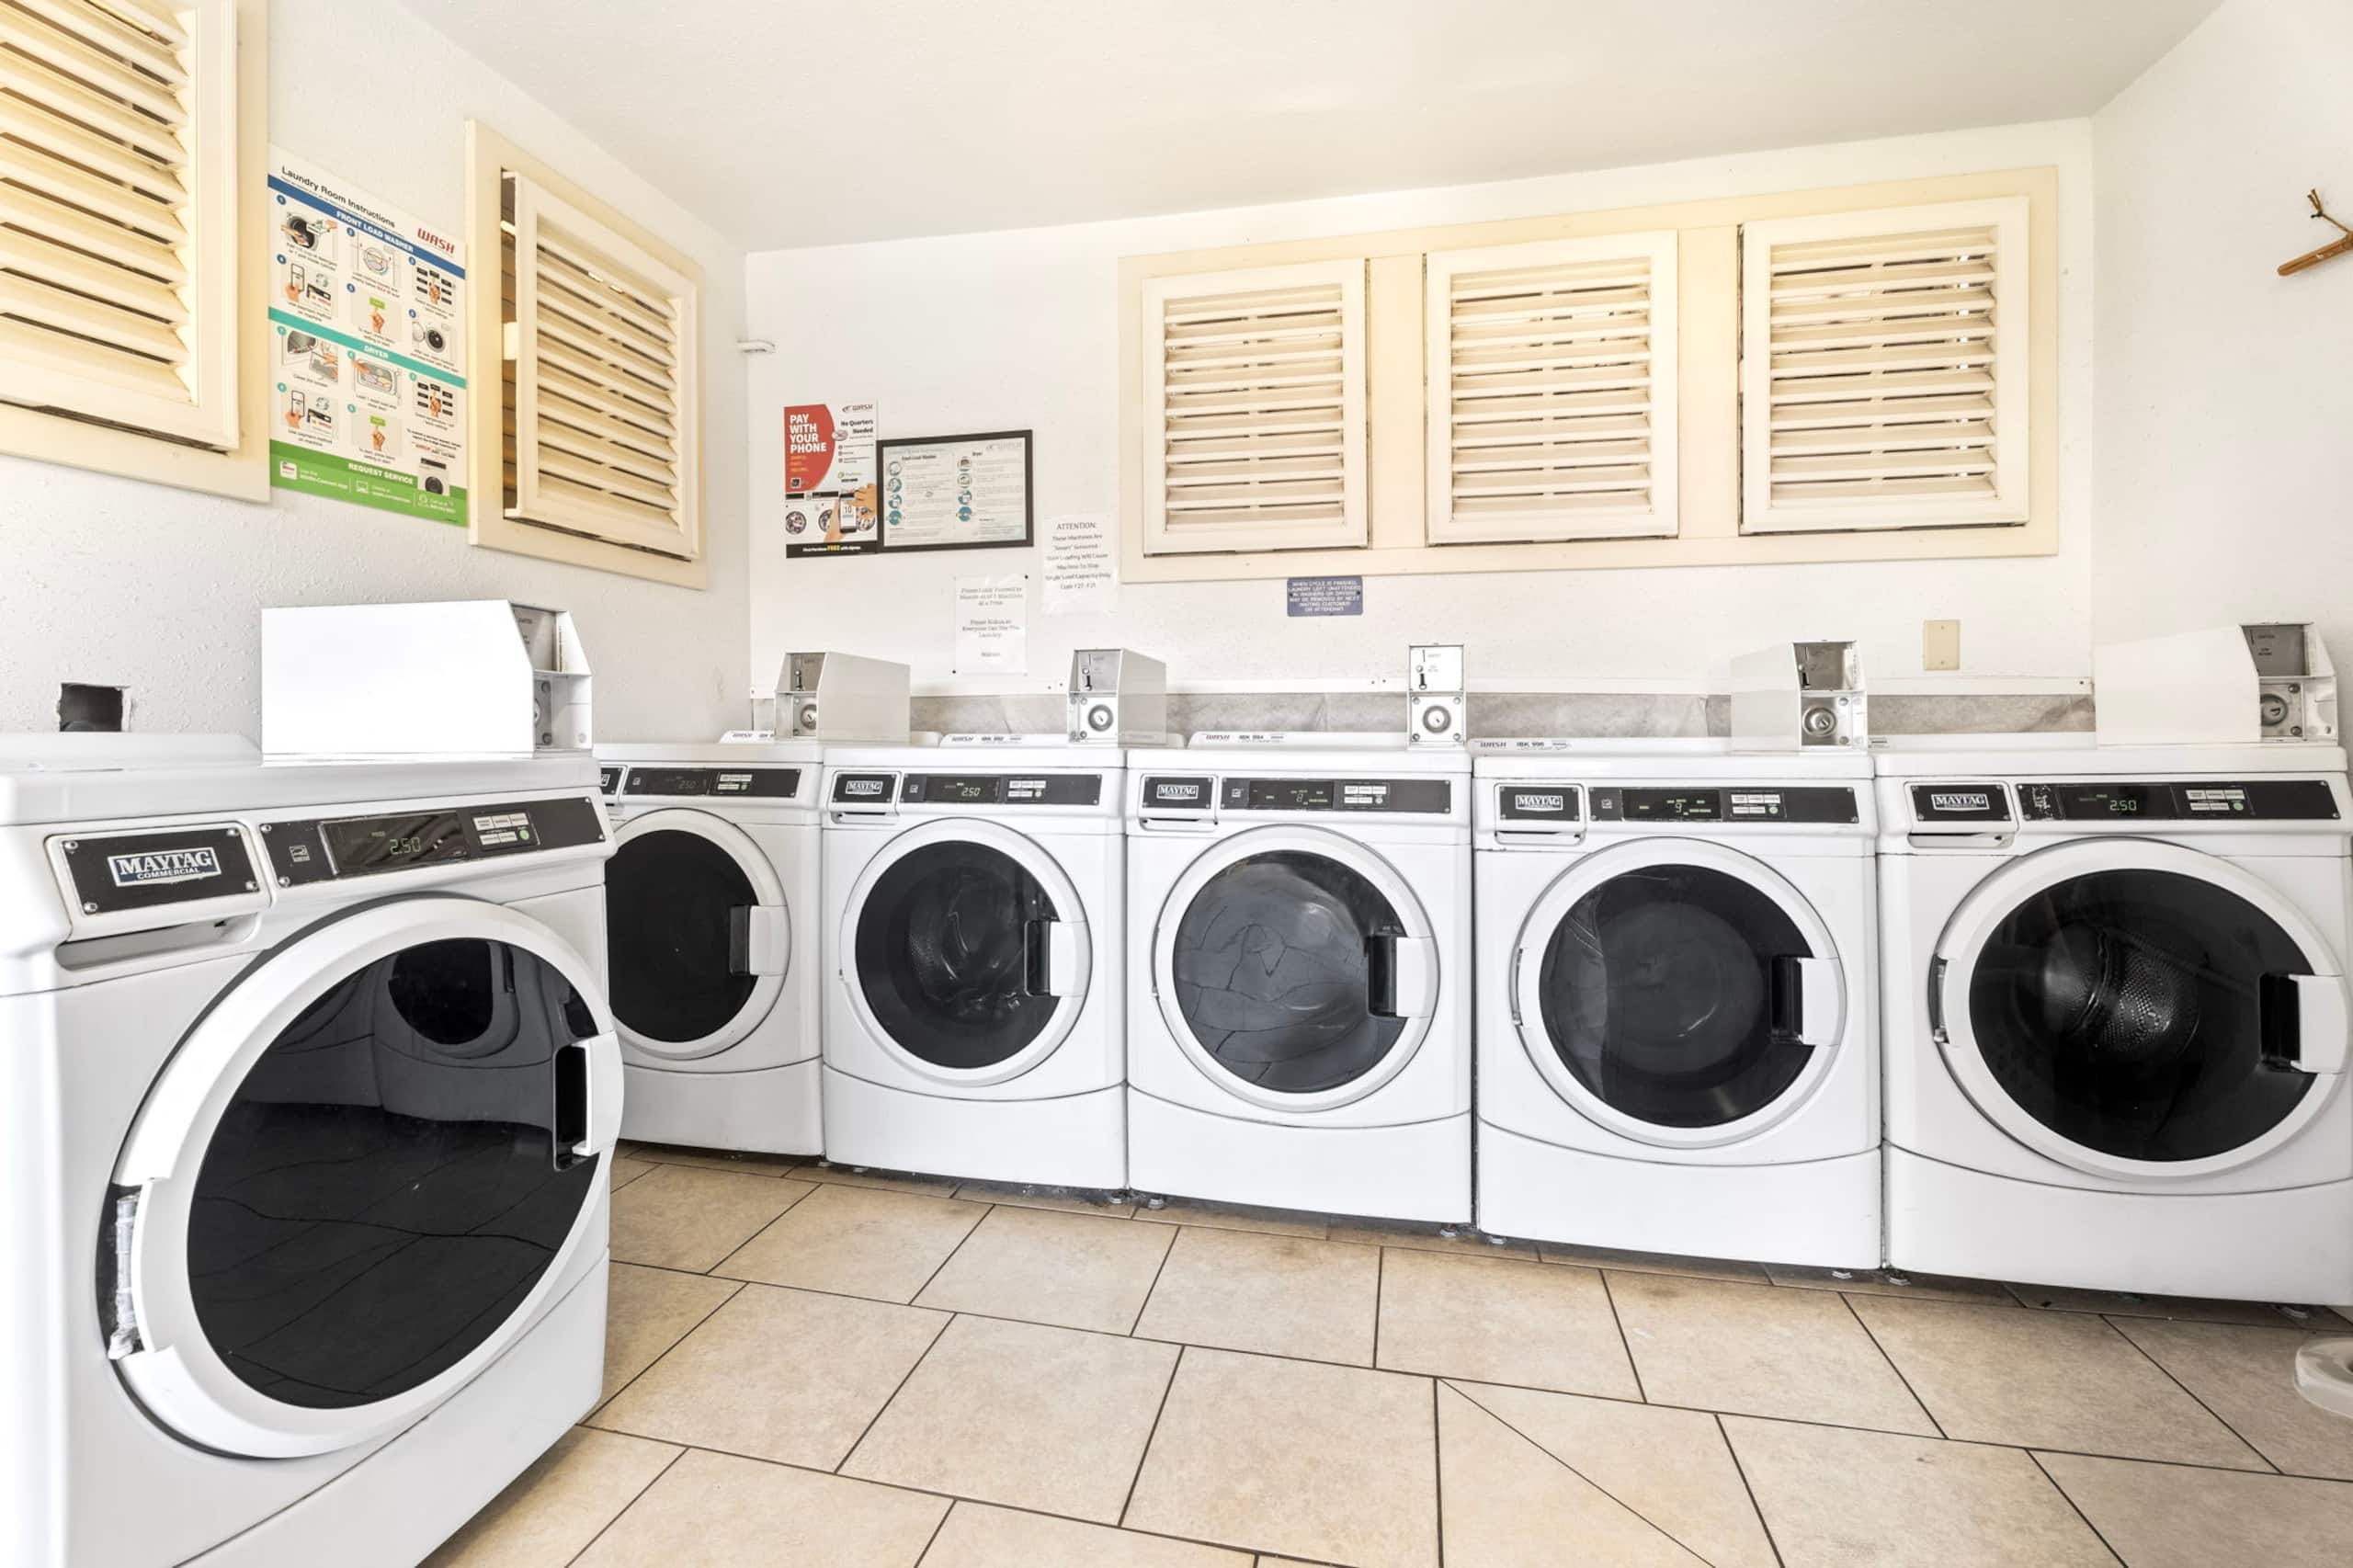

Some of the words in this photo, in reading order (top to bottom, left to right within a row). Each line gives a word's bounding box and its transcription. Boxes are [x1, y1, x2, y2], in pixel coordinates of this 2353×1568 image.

[281, 165, 319, 191] Laundry
[321, 184, 347, 204] Room
[347, 198, 396, 228] Instructions
[335, 210, 362, 230] FRONT
[363, 222, 382, 239] LOAD
[382, 230, 415, 254] WASHER
[416, 227, 455, 255] WASH
[364, 345, 389, 358] DRYER
[790, 414, 809, 424] PAY
[848, 419, 874, 427] Quarters
[790, 423, 817, 434] WITH
[790, 433, 819, 444] YOUR
[790, 442, 827, 454] PHONE
[348, 462, 383, 478] REQUEST
[384, 471, 414, 485] SERVICE
[847, 781, 881, 790] MAYTAG
[1158, 786, 1196, 795] MAYTAG
[1518, 796, 1561, 805] MAYTAG
[1936, 795, 1985, 805] MAYTAG
[2109, 800, 2137, 811] 2.50
[389, 837, 422, 856] 2.50
[116, 851, 213, 876] MAYTAG
[137, 867, 201, 881] COMMERCIAL
